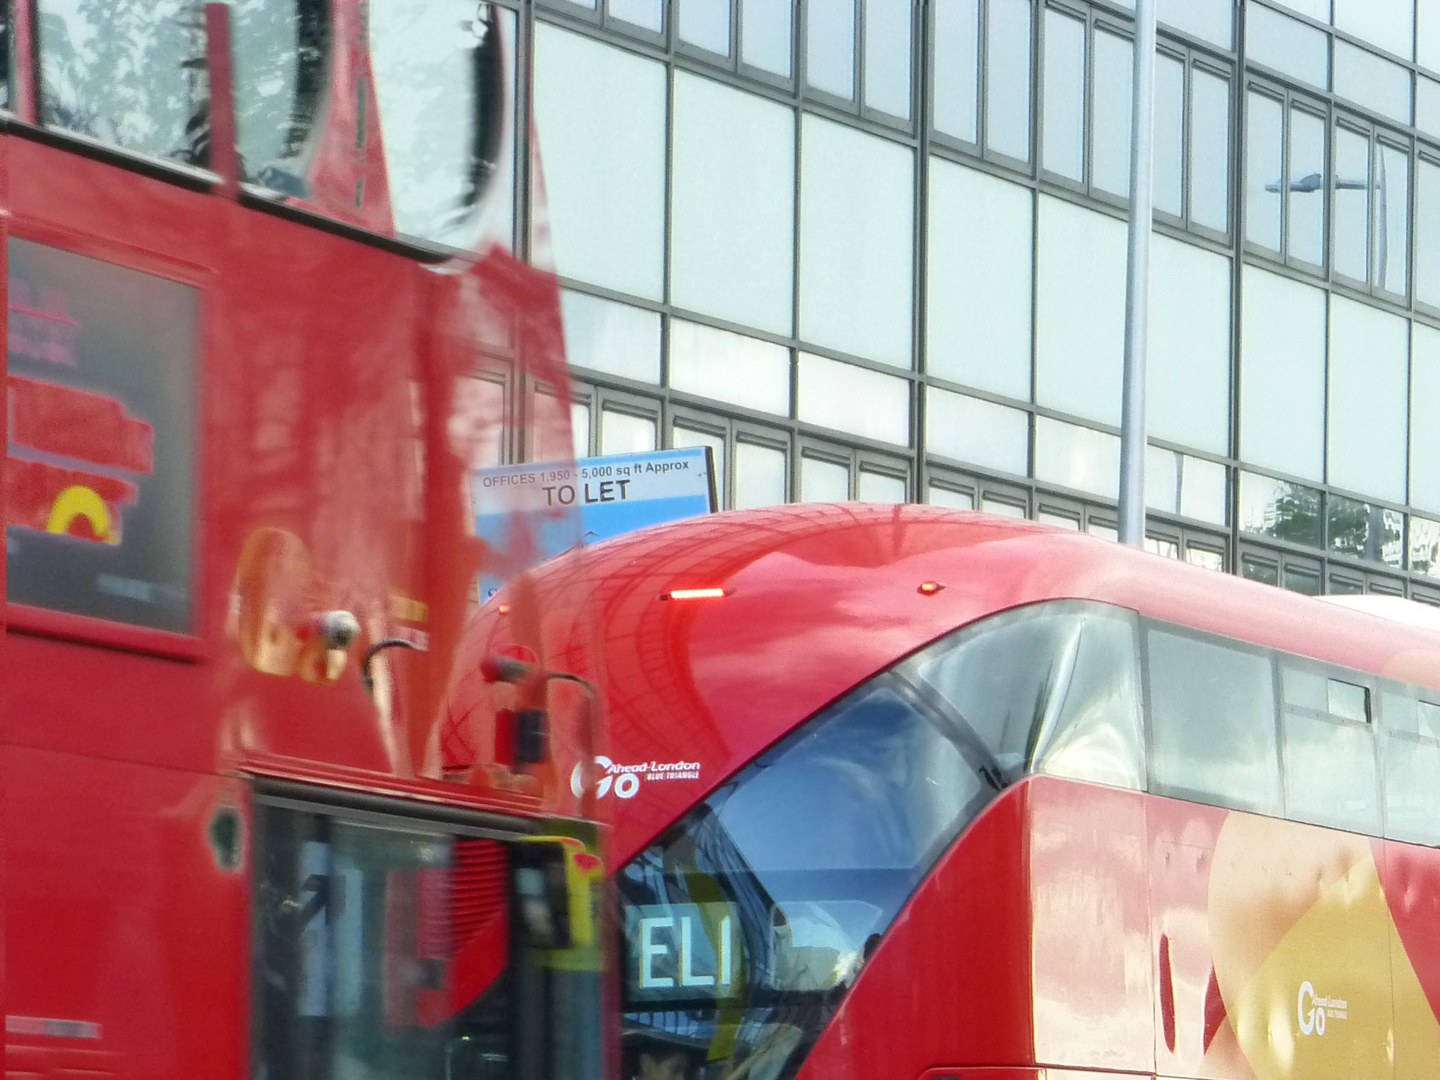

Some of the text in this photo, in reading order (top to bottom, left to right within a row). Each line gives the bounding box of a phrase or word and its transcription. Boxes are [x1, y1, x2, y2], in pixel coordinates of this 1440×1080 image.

[483, 474, 536, 488] OFFICES
[540, 470, 570, 484] 1,950
[582, 466, 612, 479] 5,000
[616, 467, 631, 478] sq
[634, 463, 643, 474] ft
[646, 460, 689, 475] Approx
[542, 479, 630, 506] TO LET
[645, 771, 700, 781] BLUE TRIANGLE
